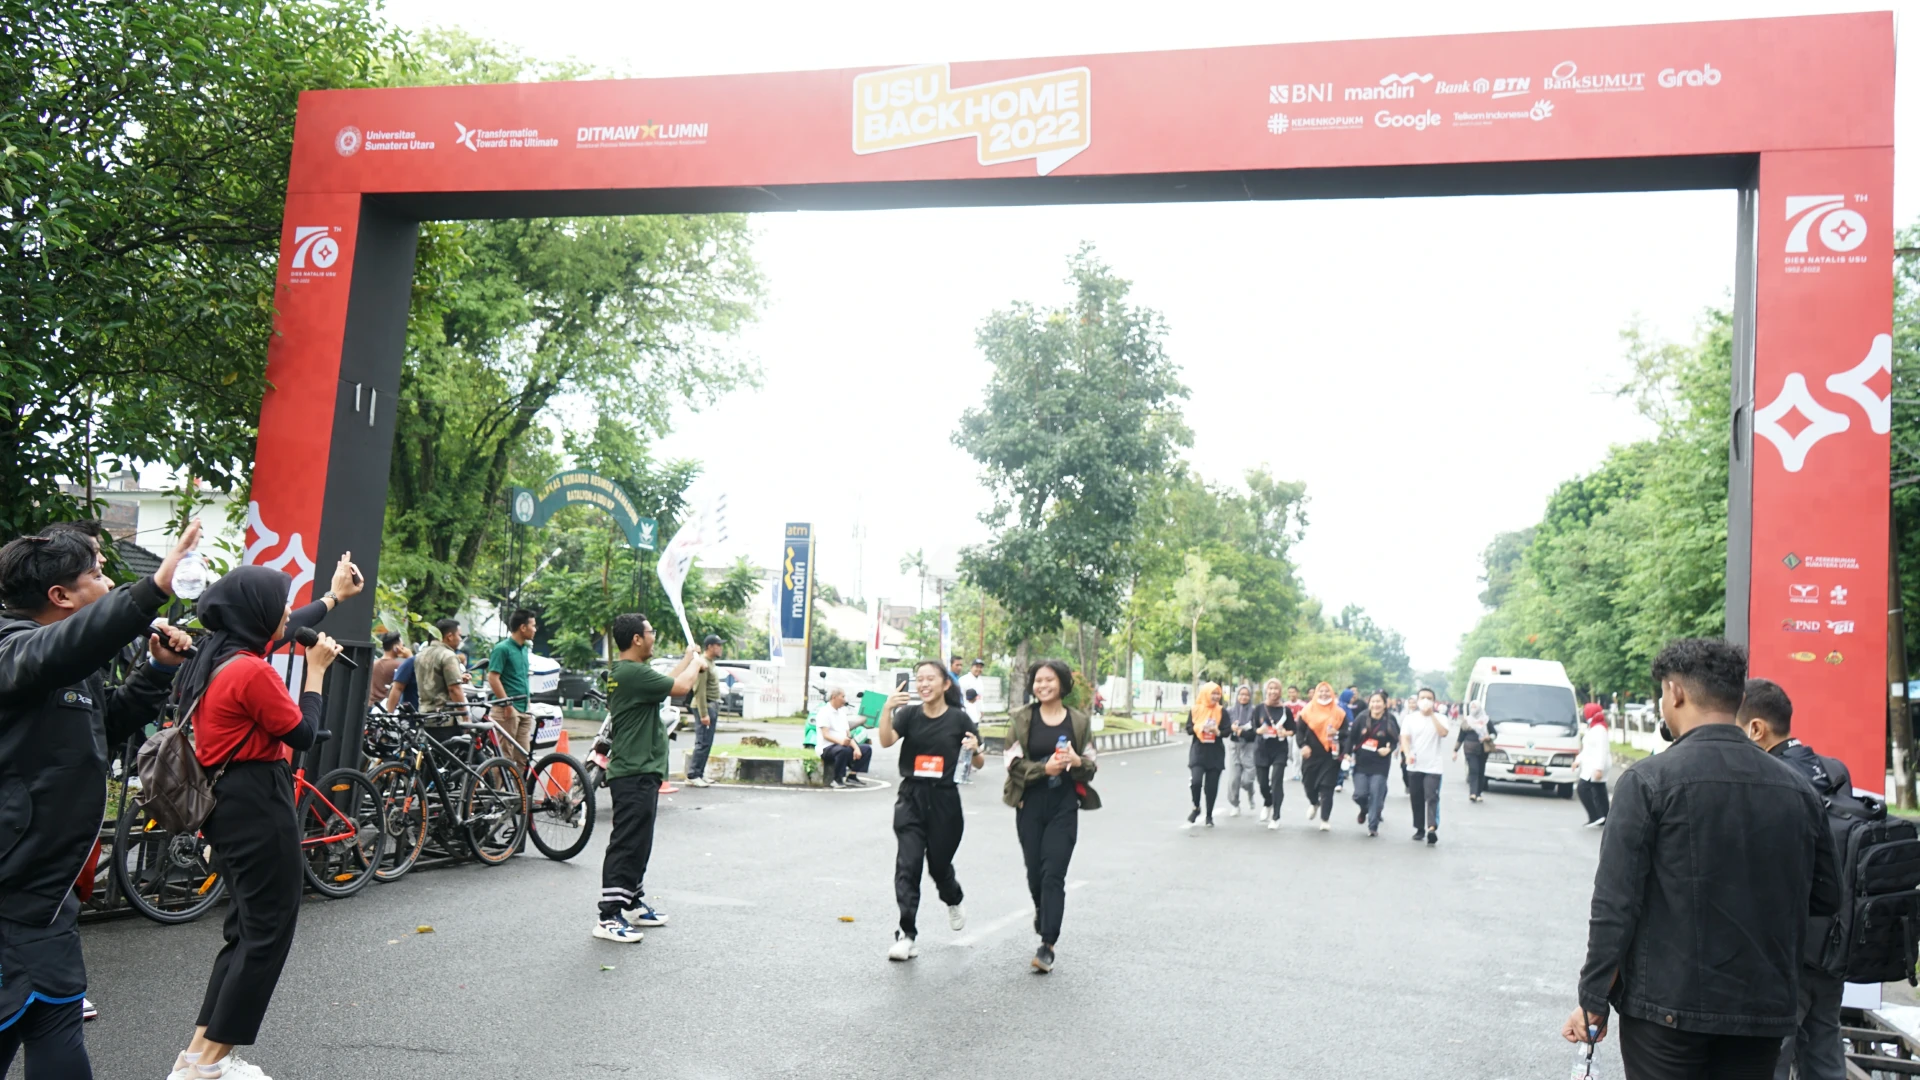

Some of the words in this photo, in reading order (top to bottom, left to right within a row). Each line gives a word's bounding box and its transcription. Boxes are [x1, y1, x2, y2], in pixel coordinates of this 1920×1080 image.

[1657, 63, 1722, 88] Grab
[864, 73, 939, 111] USU
[1344, 83, 1414, 101] mandiri
[1435, 80, 1471, 94] Bank
[1492, 77, 1531, 92] BTN
[1292, 83, 1333, 103] BNI
[864, 99, 962, 143] BACK
[965, 79, 1079, 125] HOME
[1453, 112, 1485, 120] Telkom
[1486, 110, 1528, 119] Indonesia
[1374, 109, 1441, 131] Google
[366, 130, 416, 140] Universitas
[477, 128, 538, 139] Transformation
[989, 111, 1080, 153] 2022
[365, 140, 408, 150] Sumatera
[410, 140, 435, 150] Utara
[476, 138, 507, 148] Towards
[509, 138, 523, 148] the
[524, 137, 559, 147] Ultimate
[1854, 194, 1868, 202] TH
[1784, 256, 1805, 264] DIES
[1808, 256, 1846, 264] NATALIS
[786, 526, 808, 536] atm
[791, 562, 806, 618] mandiri
[1795, 620, 1820, 630] PND
